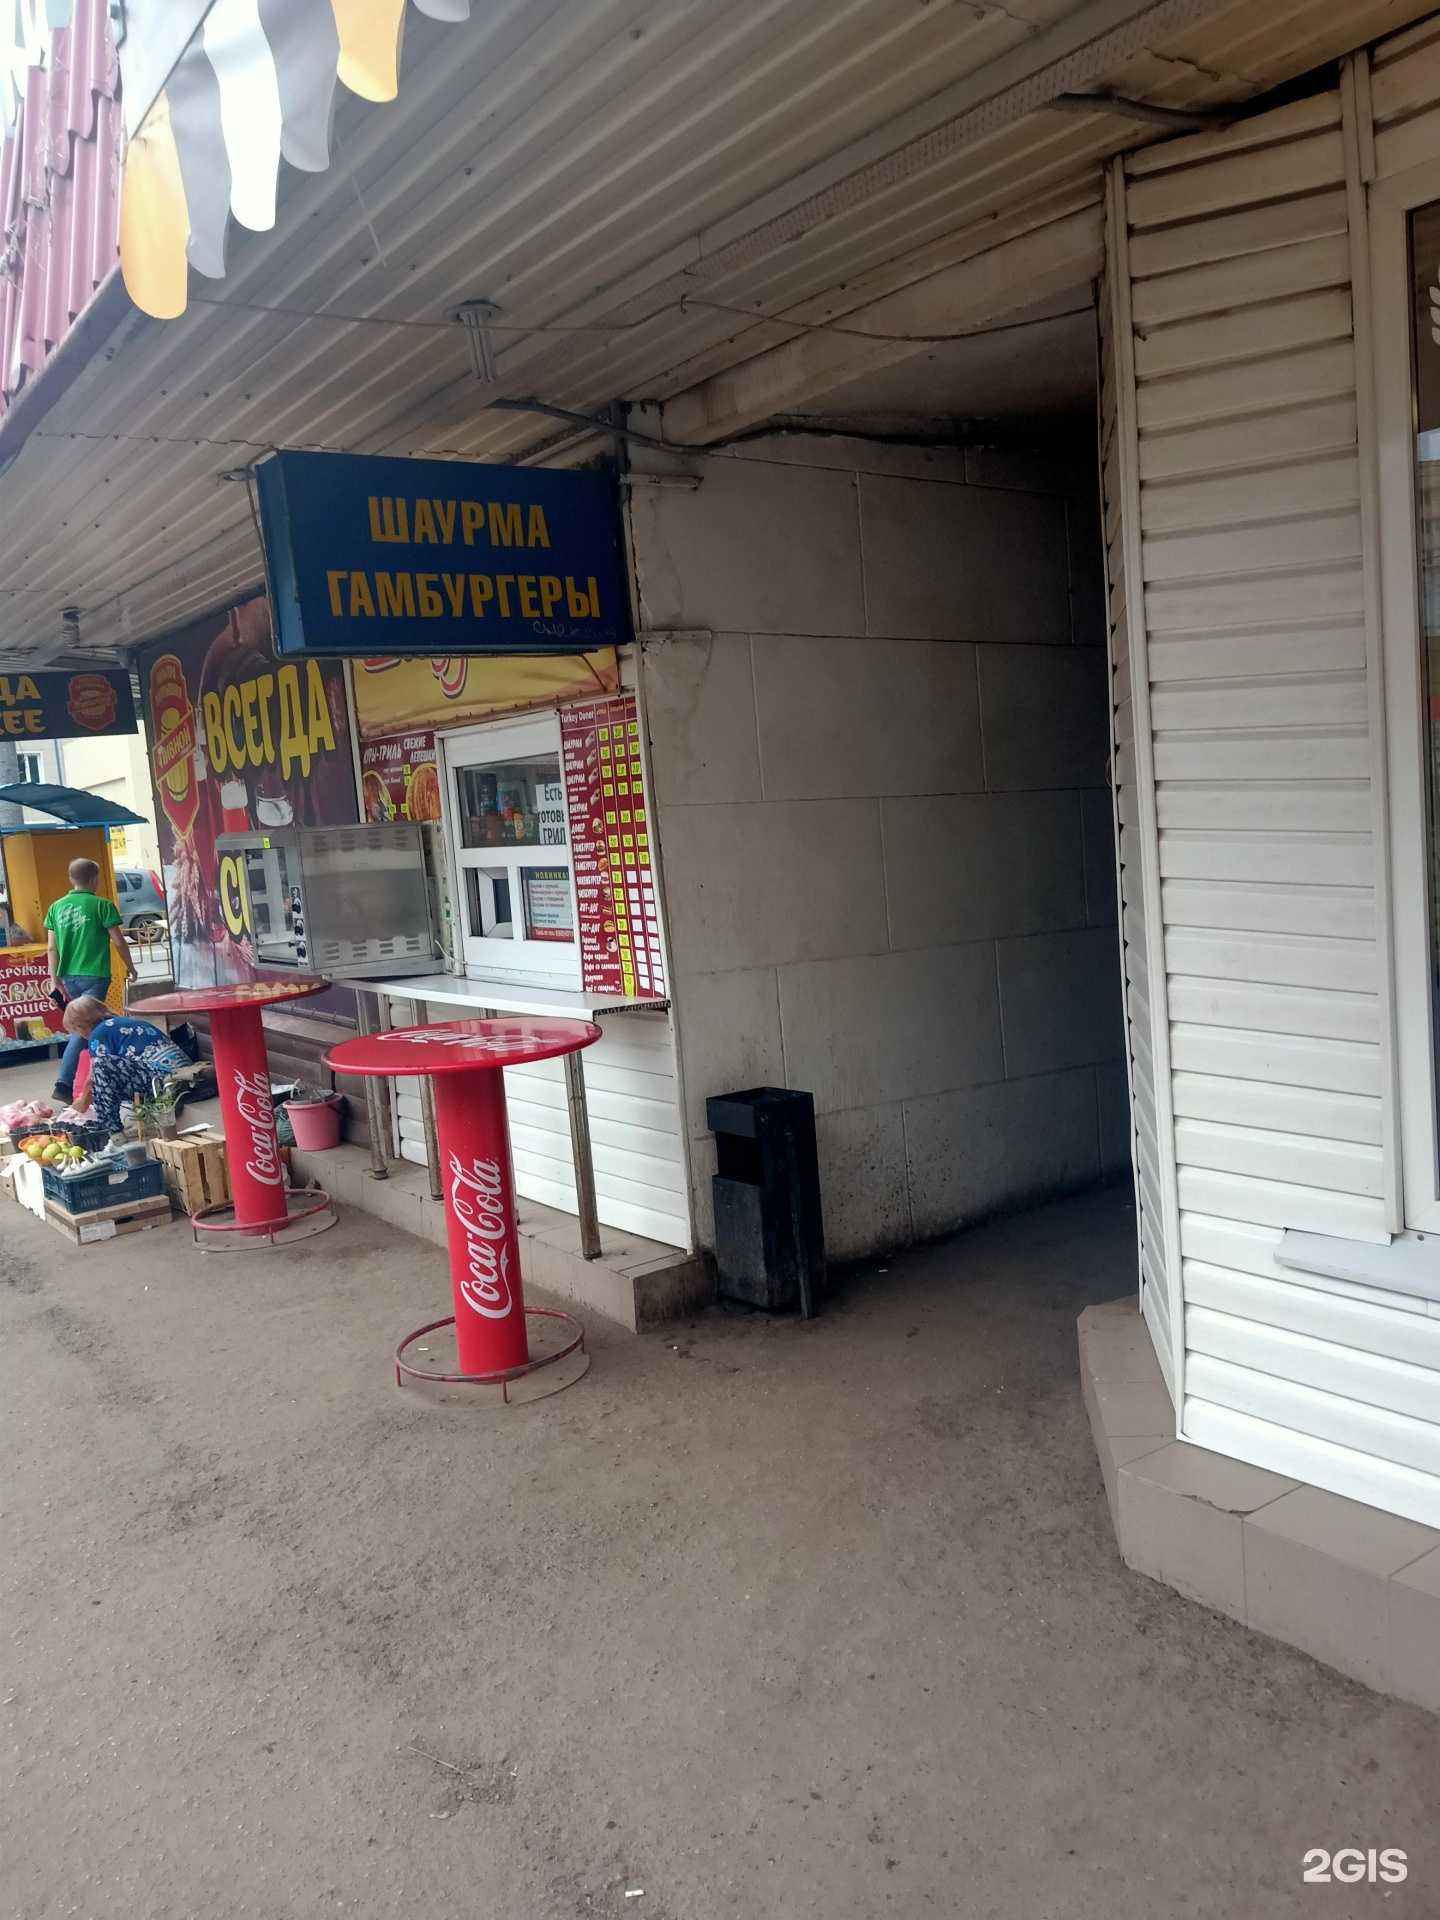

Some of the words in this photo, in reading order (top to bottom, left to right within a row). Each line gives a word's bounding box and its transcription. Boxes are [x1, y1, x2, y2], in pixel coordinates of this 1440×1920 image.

[368, 495, 551, 548] ШАУРМА
[326, 570, 600, 618] ГАМБУРГЕРЫ
[203, 657, 336, 781] ВСЕГДА
[403, 736, 426, 750] СВЕЖИЕ
[449, 1149, 513, 1319] Coca-Cola
